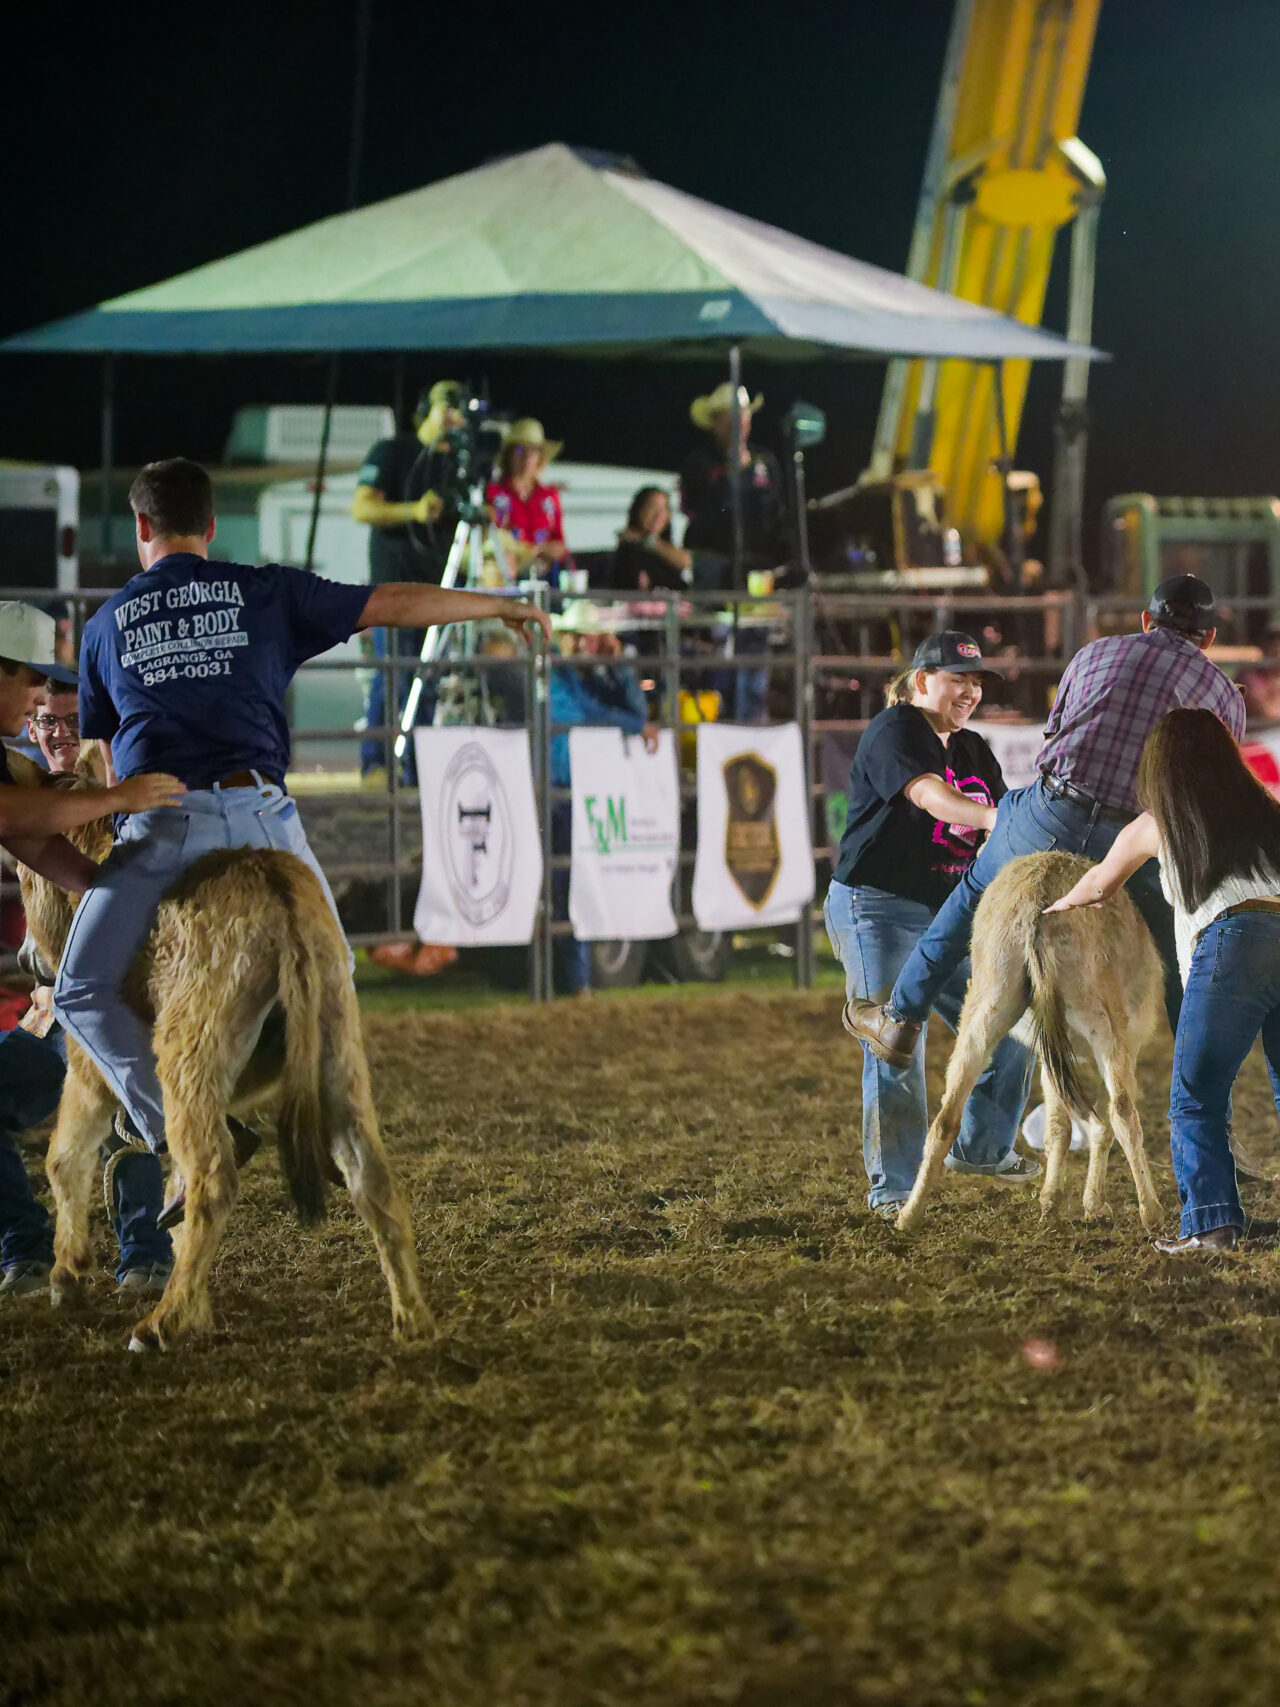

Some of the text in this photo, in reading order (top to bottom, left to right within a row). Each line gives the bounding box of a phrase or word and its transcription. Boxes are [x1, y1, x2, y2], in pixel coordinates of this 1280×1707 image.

[114, 581, 245, 631] WEST GEORGIA
[124, 607, 240, 652] PAINT & BODY
[137, 649, 234, 674] LAGRANGE, GA
[143, 661, 232, 687] 884-0031
